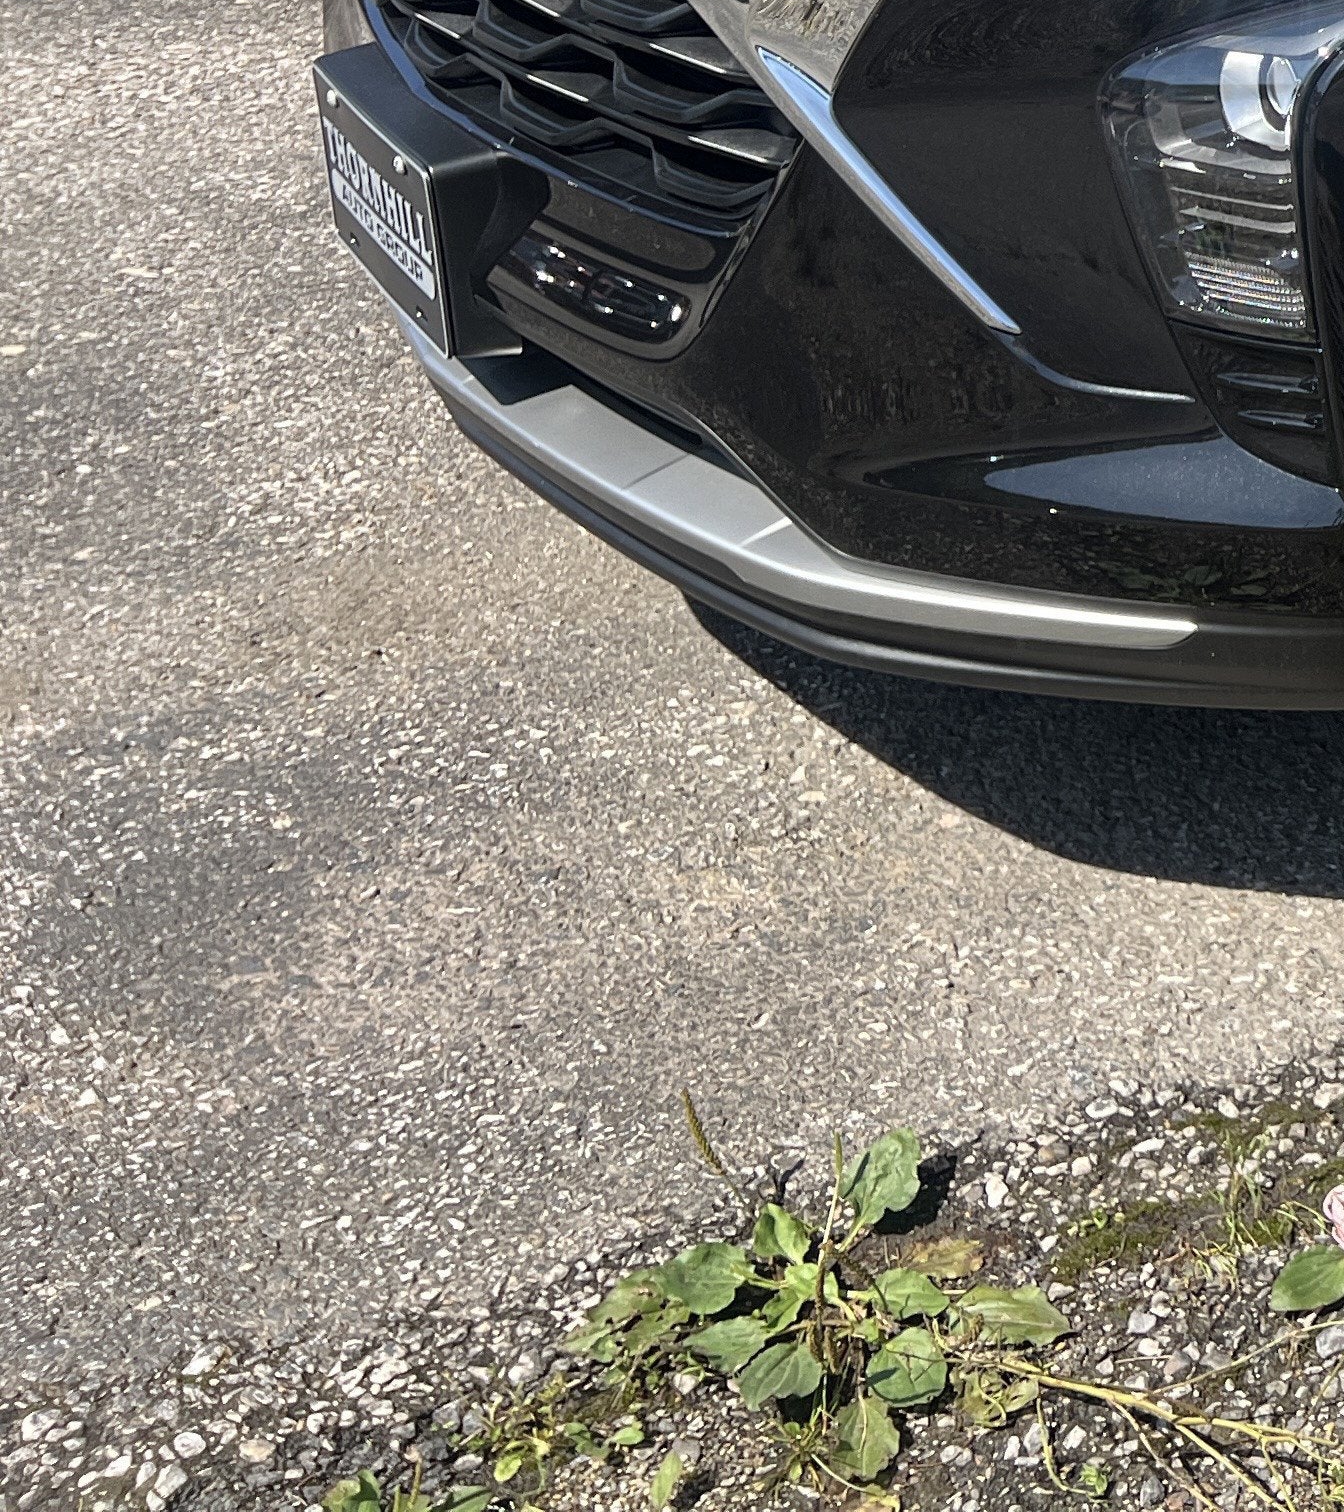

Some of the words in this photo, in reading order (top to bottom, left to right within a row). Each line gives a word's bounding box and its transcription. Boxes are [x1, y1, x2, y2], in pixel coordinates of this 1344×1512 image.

[322, 115, 433, 267] THORNHILL
[341, 183, 375, 232] AUTO
[375, 223, 424, 282] GROUP
